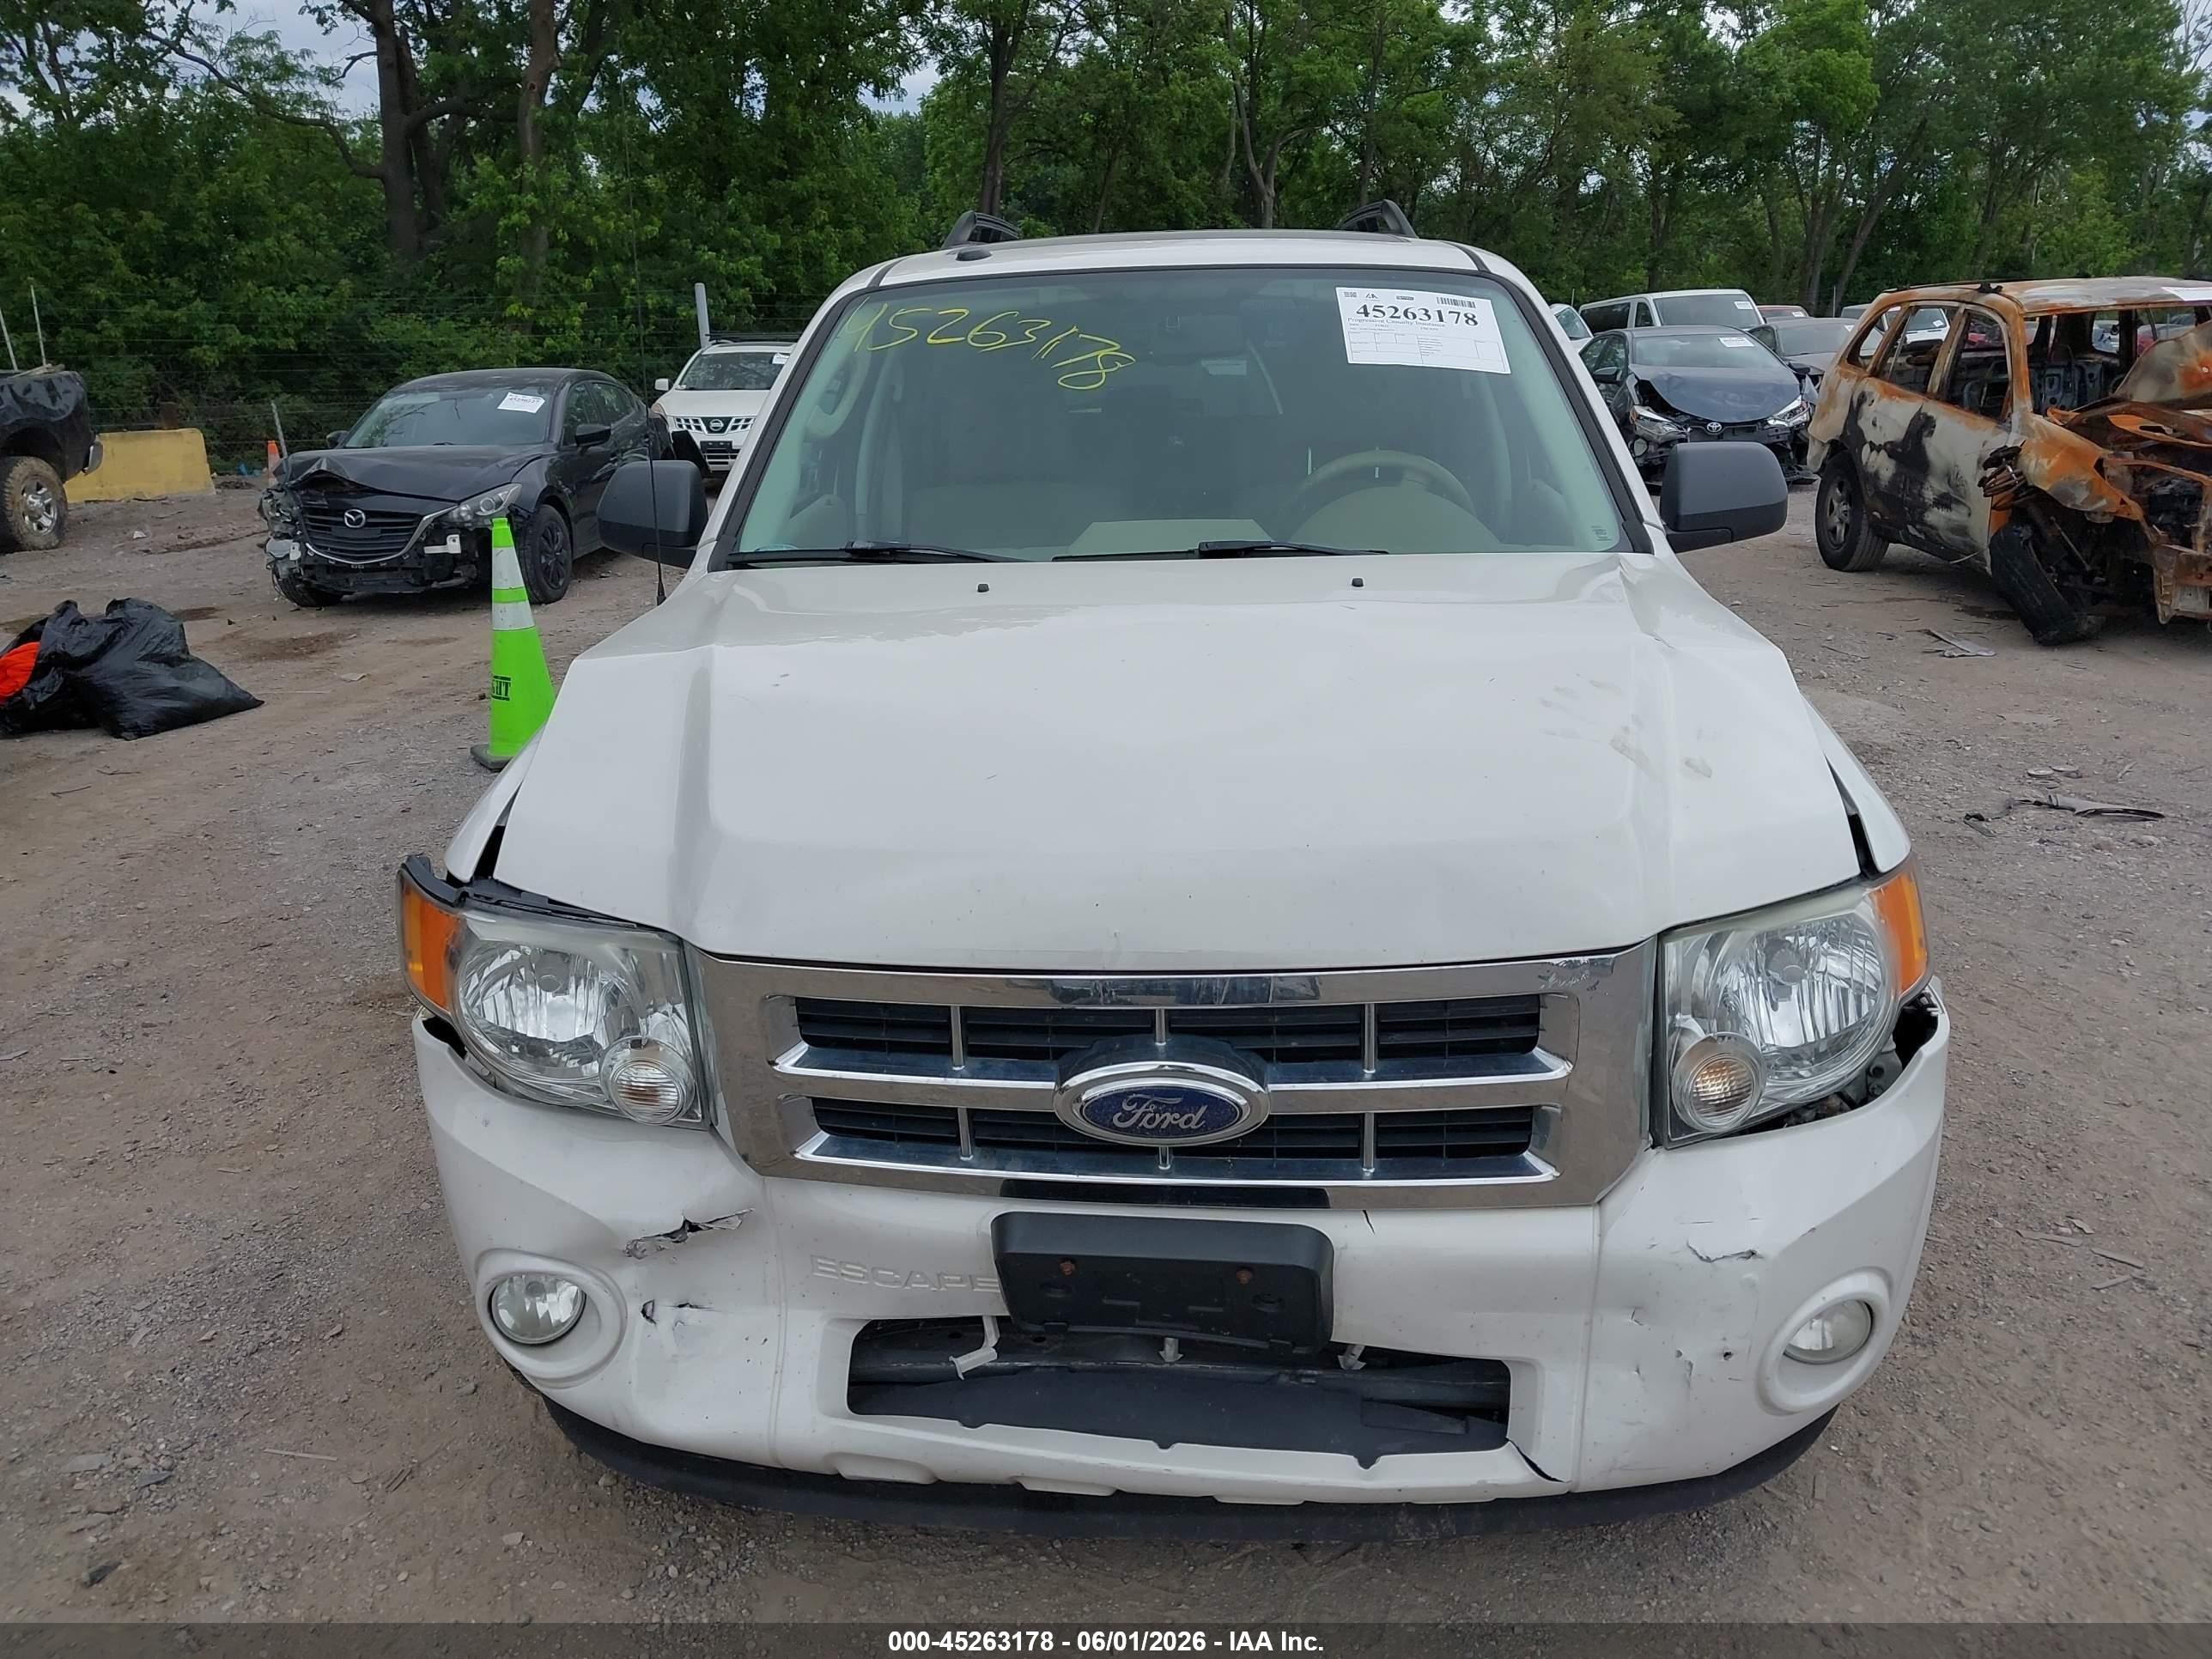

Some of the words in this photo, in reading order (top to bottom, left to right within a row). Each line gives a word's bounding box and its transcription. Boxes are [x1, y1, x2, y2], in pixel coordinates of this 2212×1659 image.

[1356, 303, 1479, 327] 45263178
[845, 296, 1136, 390] 45263178
[1113, 1094, 1206, 1130] Ford
[811, 1255, 1001, 1293] ESCAPE
